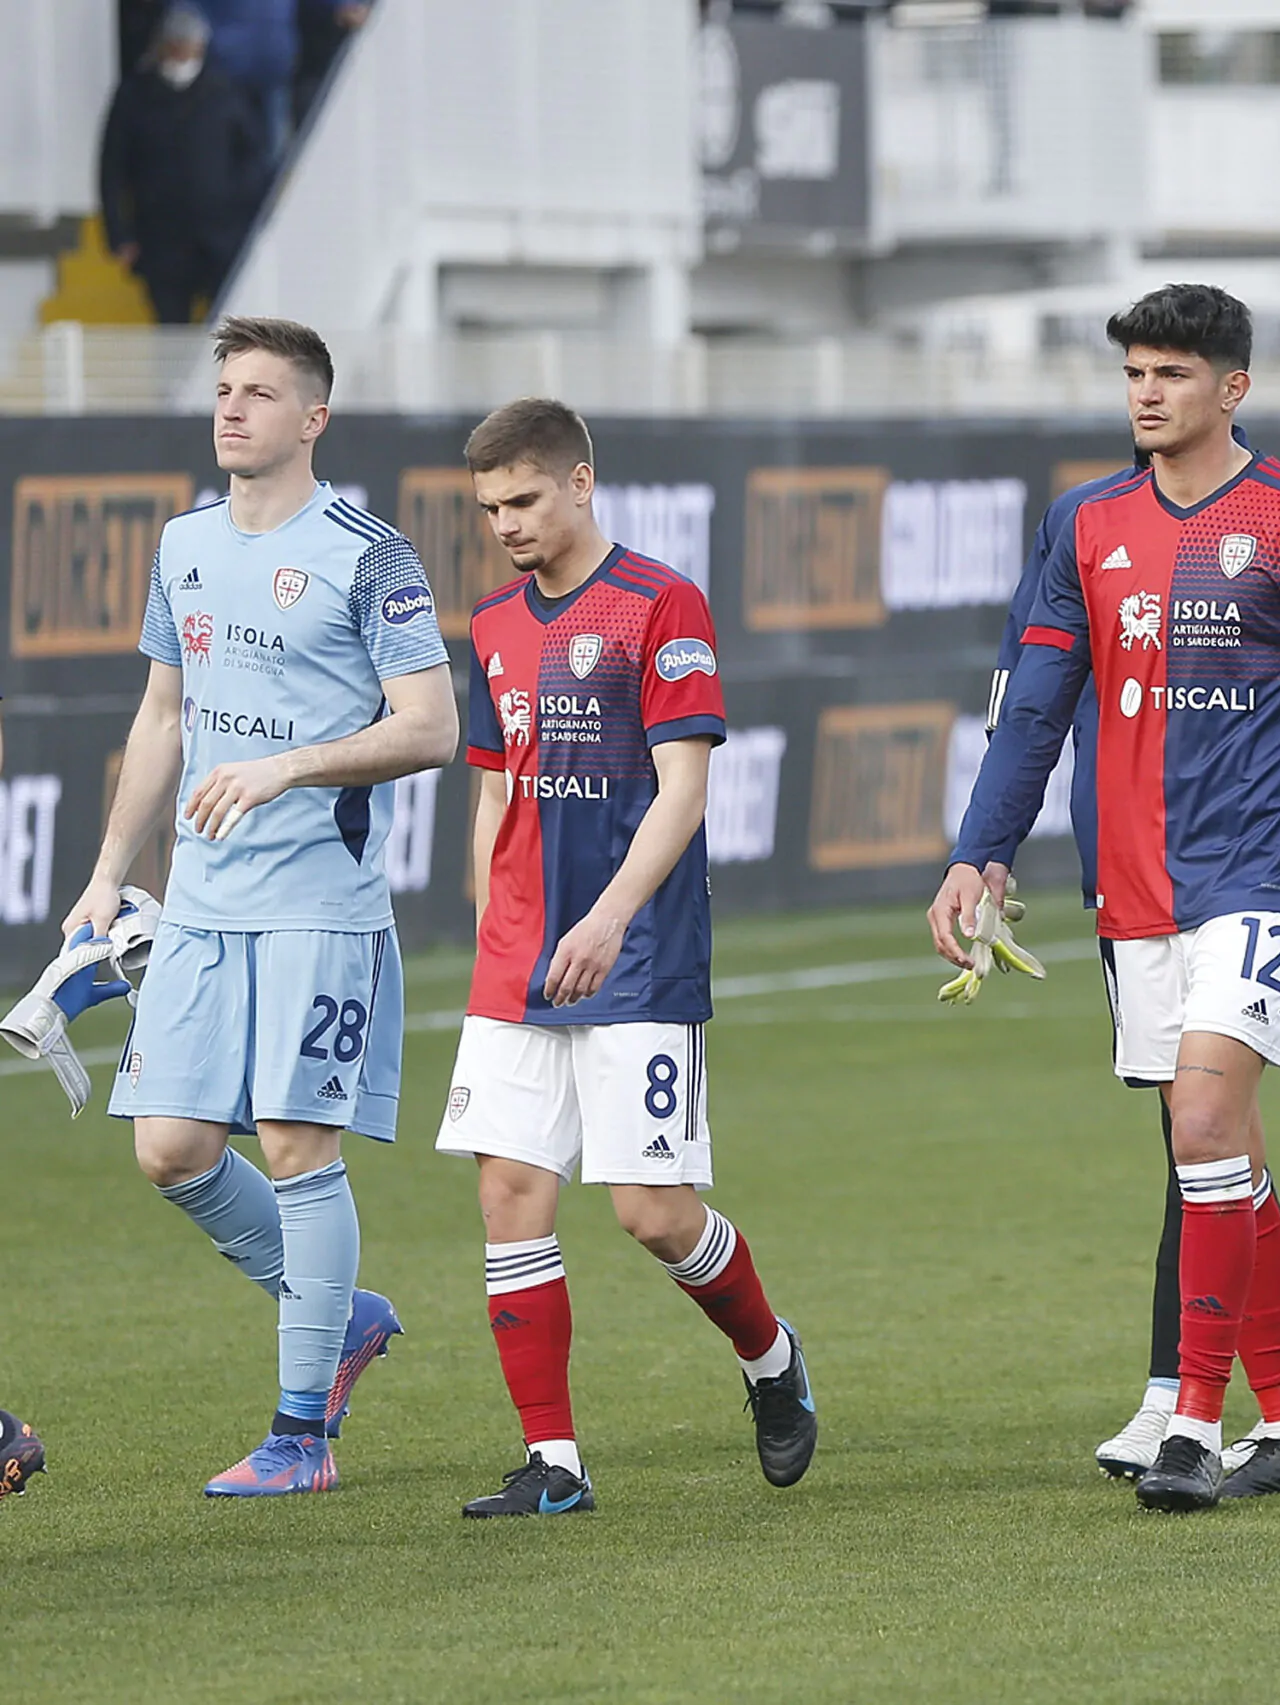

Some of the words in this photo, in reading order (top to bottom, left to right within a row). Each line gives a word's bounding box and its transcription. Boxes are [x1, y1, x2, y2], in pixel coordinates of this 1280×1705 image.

[1173, 600, 1241, 622] ISOLA
[226, 623, 285, 653] ISOLA
[1172, 624, 1242, 637] ARTIGIANATO
[1173, 636, 1185, 647] DI
[224, 646, 286, 667] ARGIANATO
[237, 659, 285, 677] SRDEGNA
[540, 695, 601, 716] ISOLA
[1150, 686, 1255, 711] TISCALI
[201, 708, 294, 741] TISCALI
[518, 775, 608, 799] TISCALI
[300, 993, 367, 1063] 28
[644, 1053, 679, 1119] 8
[641, 1148, 676, 1160] adidas
